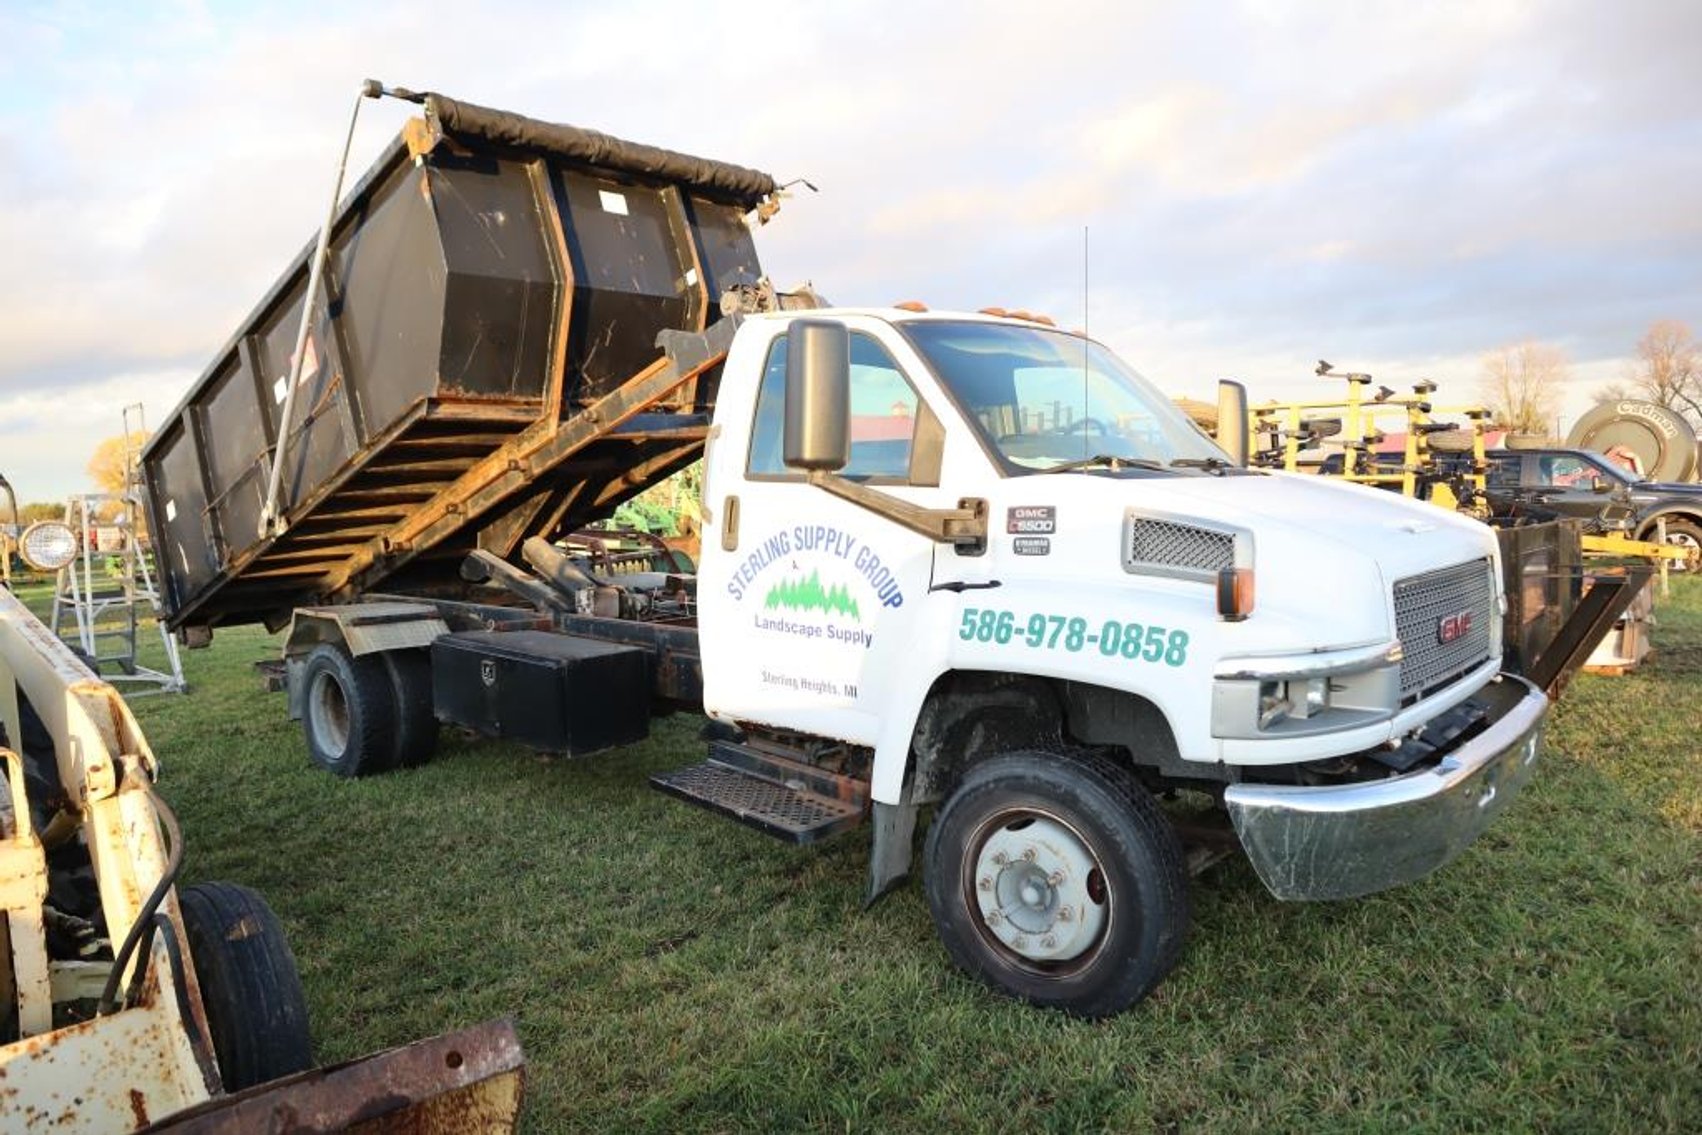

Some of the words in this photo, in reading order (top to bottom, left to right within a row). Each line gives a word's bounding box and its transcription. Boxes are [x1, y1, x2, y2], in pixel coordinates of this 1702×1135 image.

[1617, 400, 1678, 439] Cadman
[1015, 508, 1048, 518] GMC
[727, 531, 791, 601] STERLING
[794, 525, 856, 559] SUPPLY
[854, 545, 903, 608] GROUP
[754, 614, 823, 638] Landscape
[827, 625, 872, 648] Supply
[959, 608, 1189, 667] 586-978-0858
[1441, 611, 1473, 642] GMC
[761, 670, 799, 690] Sterling
[844, 684, 857, 698] MI
